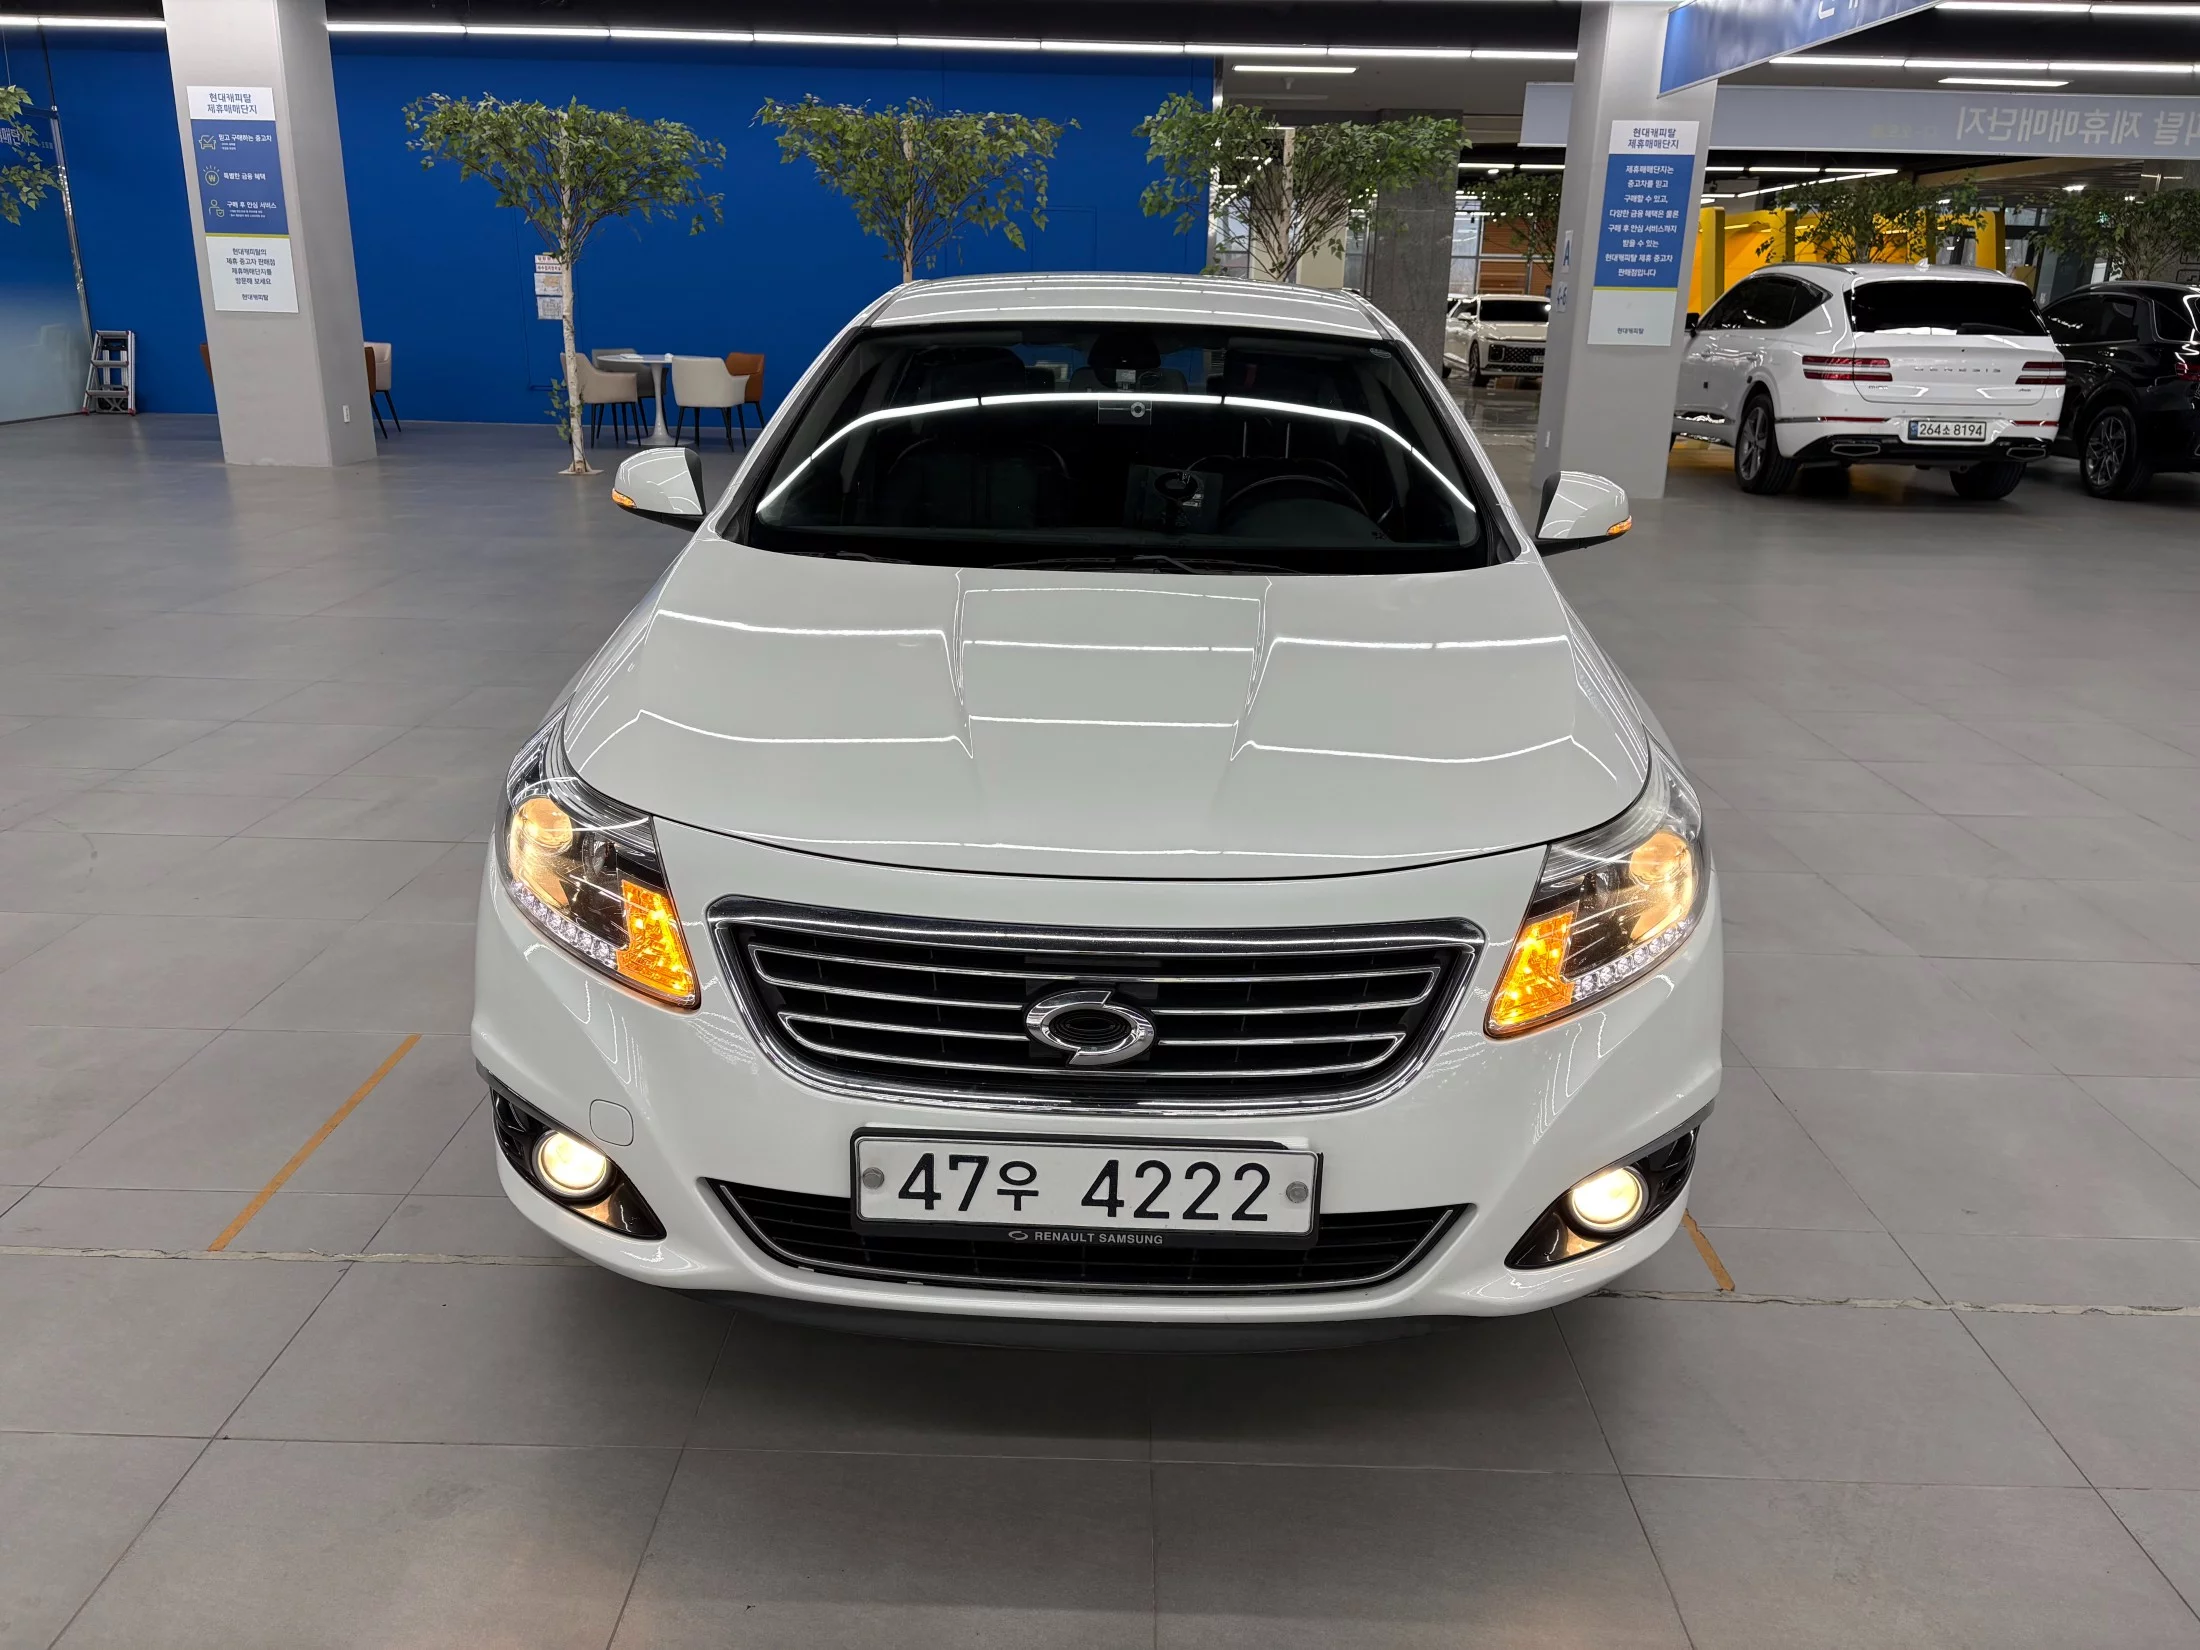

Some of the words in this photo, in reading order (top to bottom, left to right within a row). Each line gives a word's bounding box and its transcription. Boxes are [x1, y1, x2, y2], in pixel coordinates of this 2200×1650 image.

[209, 93, 251, 103] 현대캐피탈
[207, 104, 258, 114] 제휴매매단지
[1633, 128, 1676, 138] 현대캐피탈
[255, 134, 272, 142] 중고차
[1628, 139, 1679, 149] 제휴매매단지
[1625, 165, 1674, 174] 제휴매매단지는
[1628, 180, 1653, 188] 중고차를
[1645, 195, 1652, 203] 수
[1609, 209, 1629, 218] 다양한
[1608, 224, 1621, 232] 구매
[1623, 224, 1630, 232] 후
[1631, 225, 1644, 233] 안심
[1645, 225, 1677, 233] 서비스까지
[1646, 240, 1659, 248] 있는
[1563, 240, 1570, 266] A
[1605, 253, 1637, 262] 현대캐피탈
[1653, 254, 1673, 262] 중고차
[1618, 268, 1656, 277] 판매점입니다
[242, 293, 269, 301] 현대캐피탈
[1617, 327, 1644, 335] 현대캐피탈
[1919, 423, 1950, 435] 264소
[1953, 424, 1982, 436] 8194
[898, 1152, 1039, 1212] 47우
[1080, 1158, 1271, 1222] 4222
[1034, 1231, 1094, 1242] RENAULT
[1099, 1233, 1163, 1244] SAMSUNG
